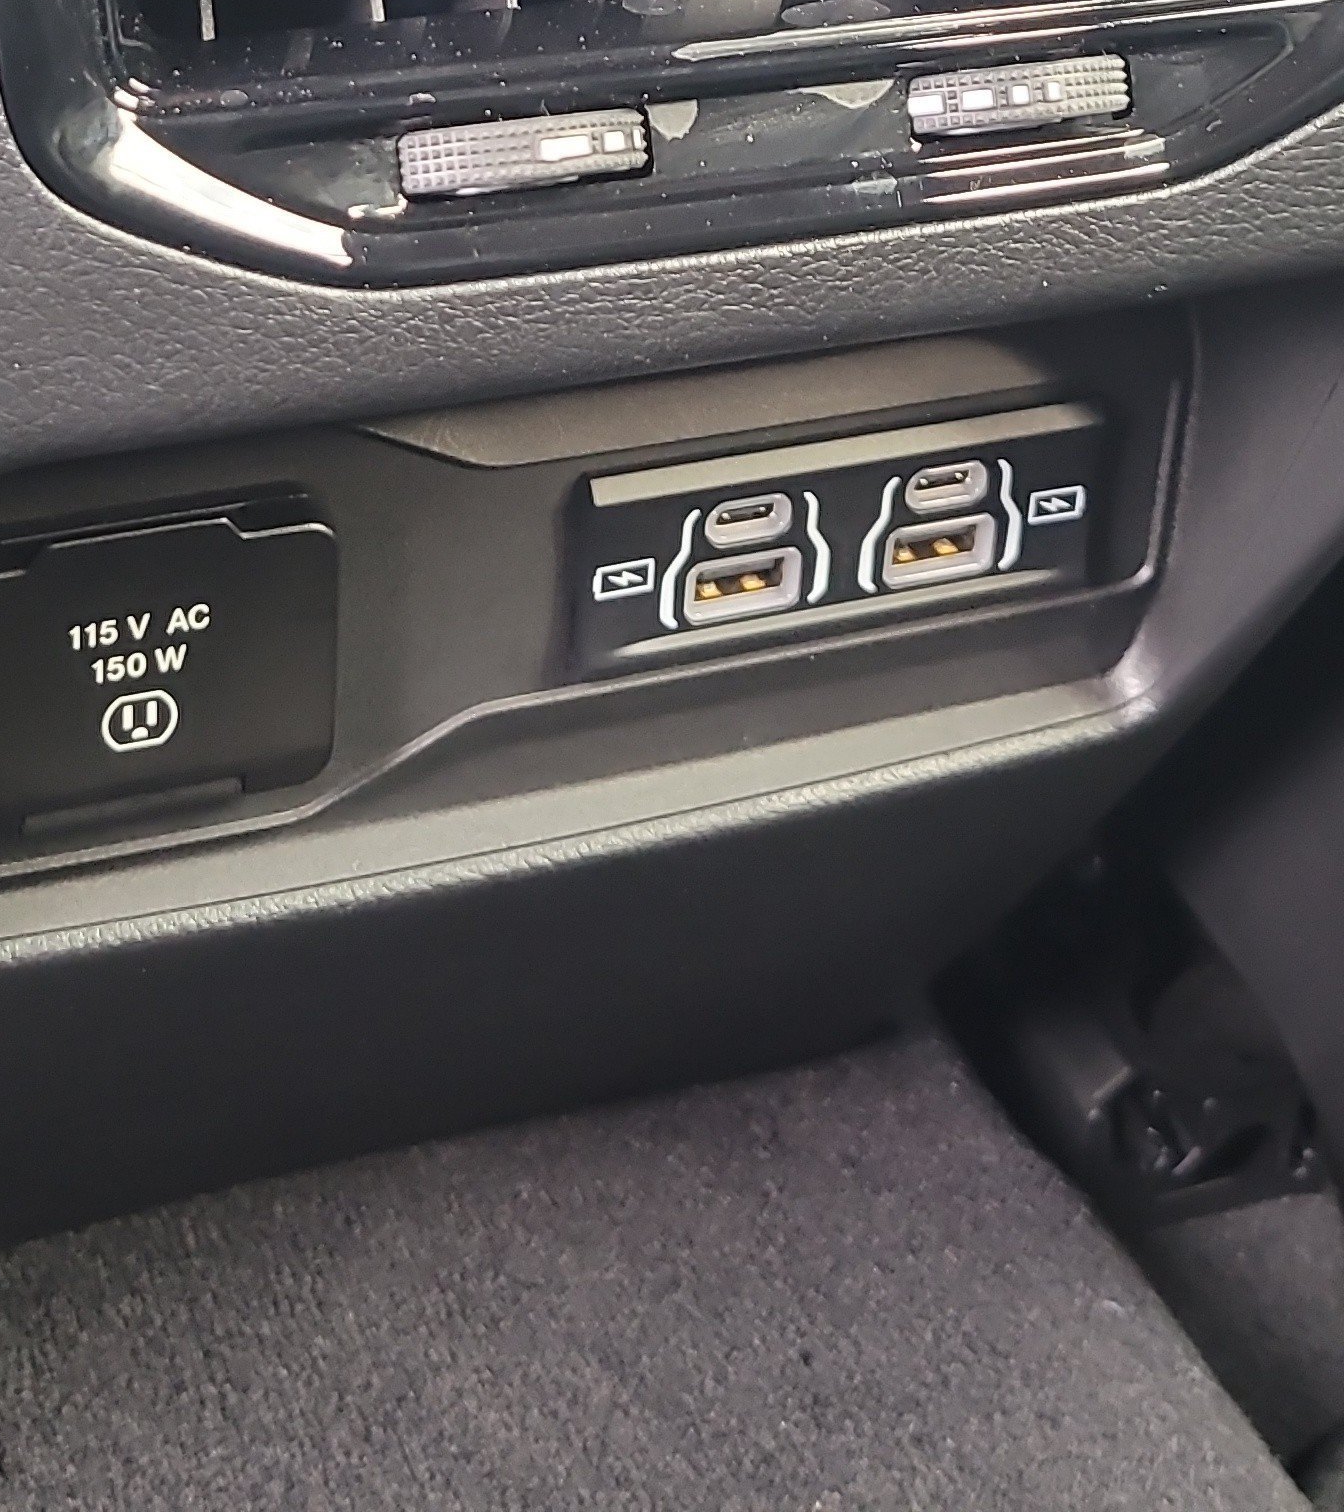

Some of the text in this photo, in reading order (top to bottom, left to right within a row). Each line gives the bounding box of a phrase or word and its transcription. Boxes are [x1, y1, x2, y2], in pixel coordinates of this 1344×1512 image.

[68, 603, 210, 651] 115 V AC
[90, 643, 187, 684] 150 W
